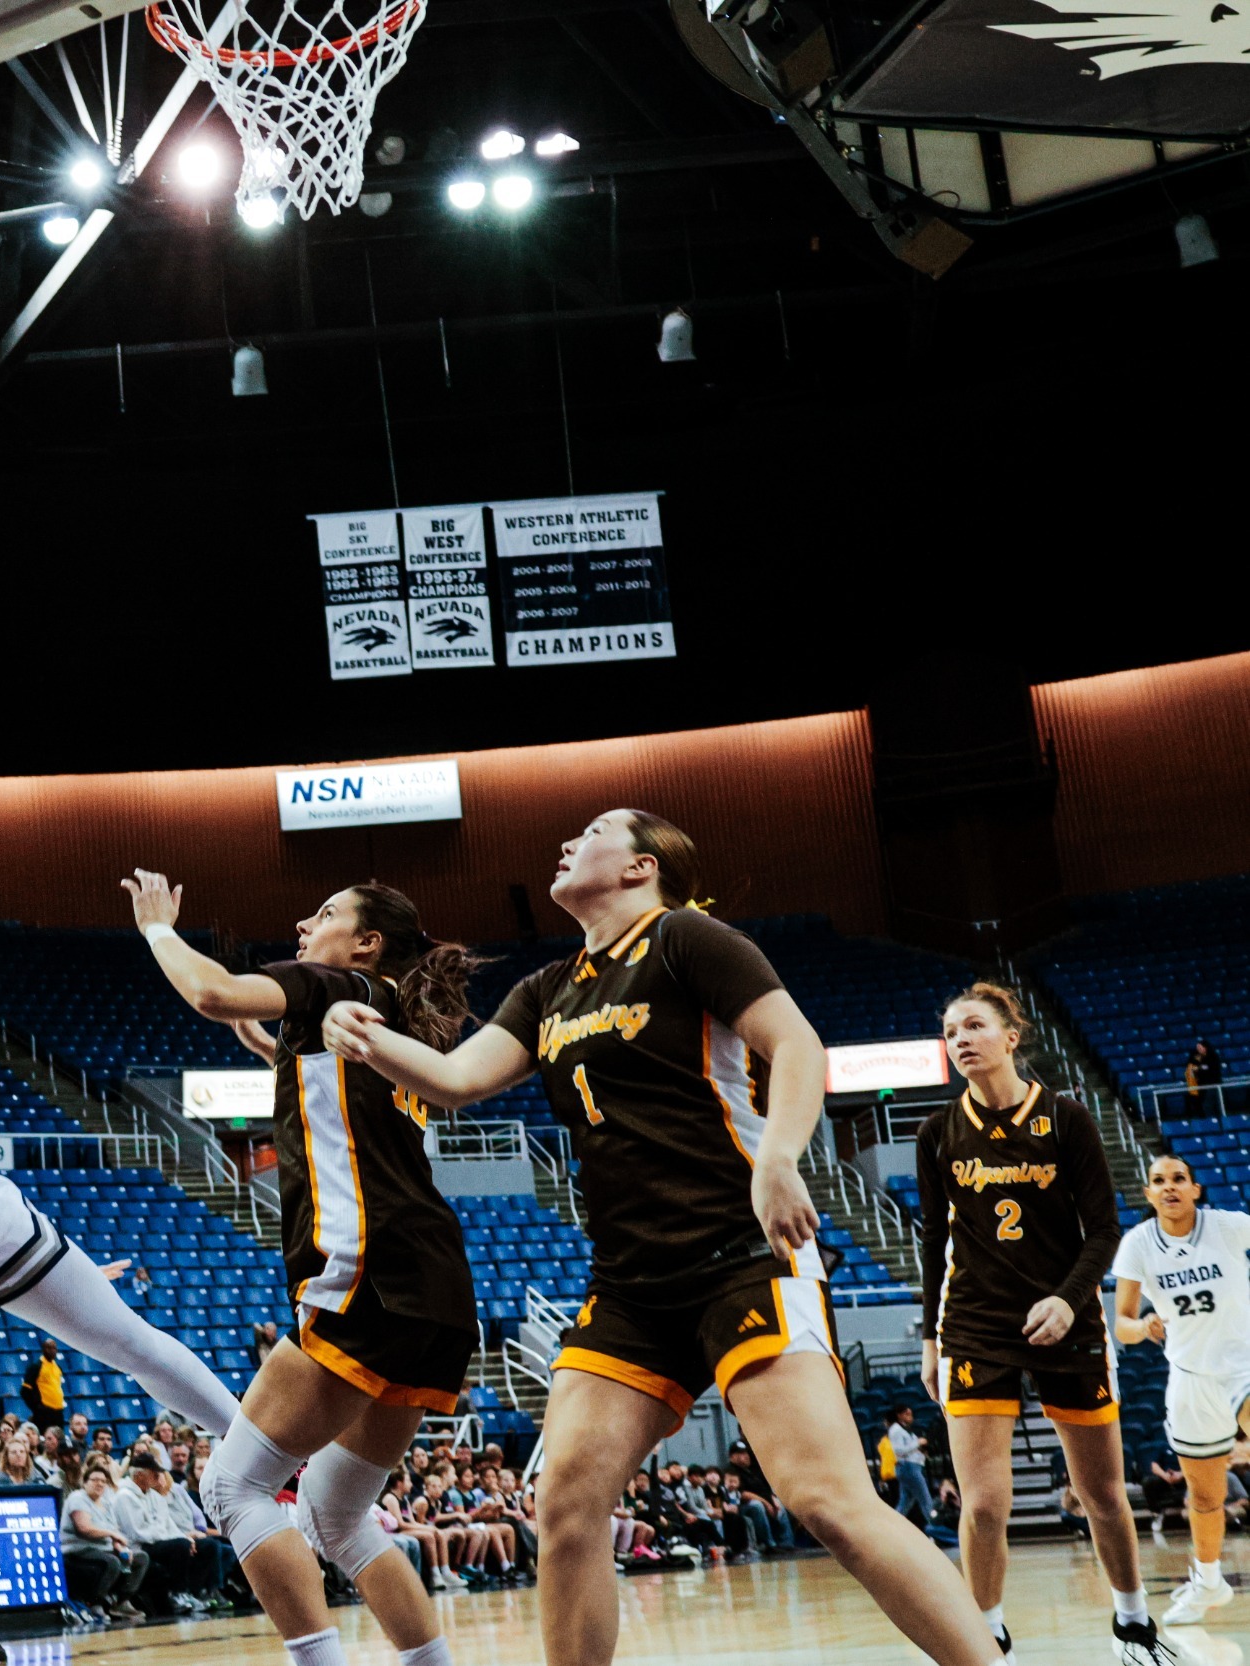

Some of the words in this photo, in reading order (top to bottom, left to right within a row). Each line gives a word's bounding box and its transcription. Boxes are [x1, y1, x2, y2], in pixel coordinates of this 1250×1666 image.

[349, 522, 367, 531] BIG
[430, 519, 455, 533] BIG
[504, 513, 574, 530] WESTERN
[579, 508, 649, 524] ATHLETIC
[349, 535, 369, 544] SKY
[424, 535, 465, 549] WEST
[532, 529, 626, 546] CONFERENCE
[324, 545, 397, 560] CONFERENCE
[409, 551, 482, 565] CONFERENCE
[415, 570, 476, 584] 1996-97
[329, 589, 399, 603] CHAMPIONS
[409, 583, 487, 597] CHAMPIONS
[415, 601, 485, 622] NEVADA
[333, 609, 402, 632] NEVADA
[518, 632, 663, 656] CHAMPIONS
[416, 647, 489, 659] BASKETBALL
[335, 656, 407, 670] BASKETBALL
[291, 776, 363, 803] NSN
[372, 770, 447, 787] NEVADA
[538, 1002, 650, 1063] Wyoming
[572, 1063, 605, 1127] 1
[952, 1157, 1057, 1193] Wyoming
[994, 1199, 1024, 1241] 2
[1156, 1263, 1223, 1290] NEVADA
[1173, 1290, 1215, 1316] 23
